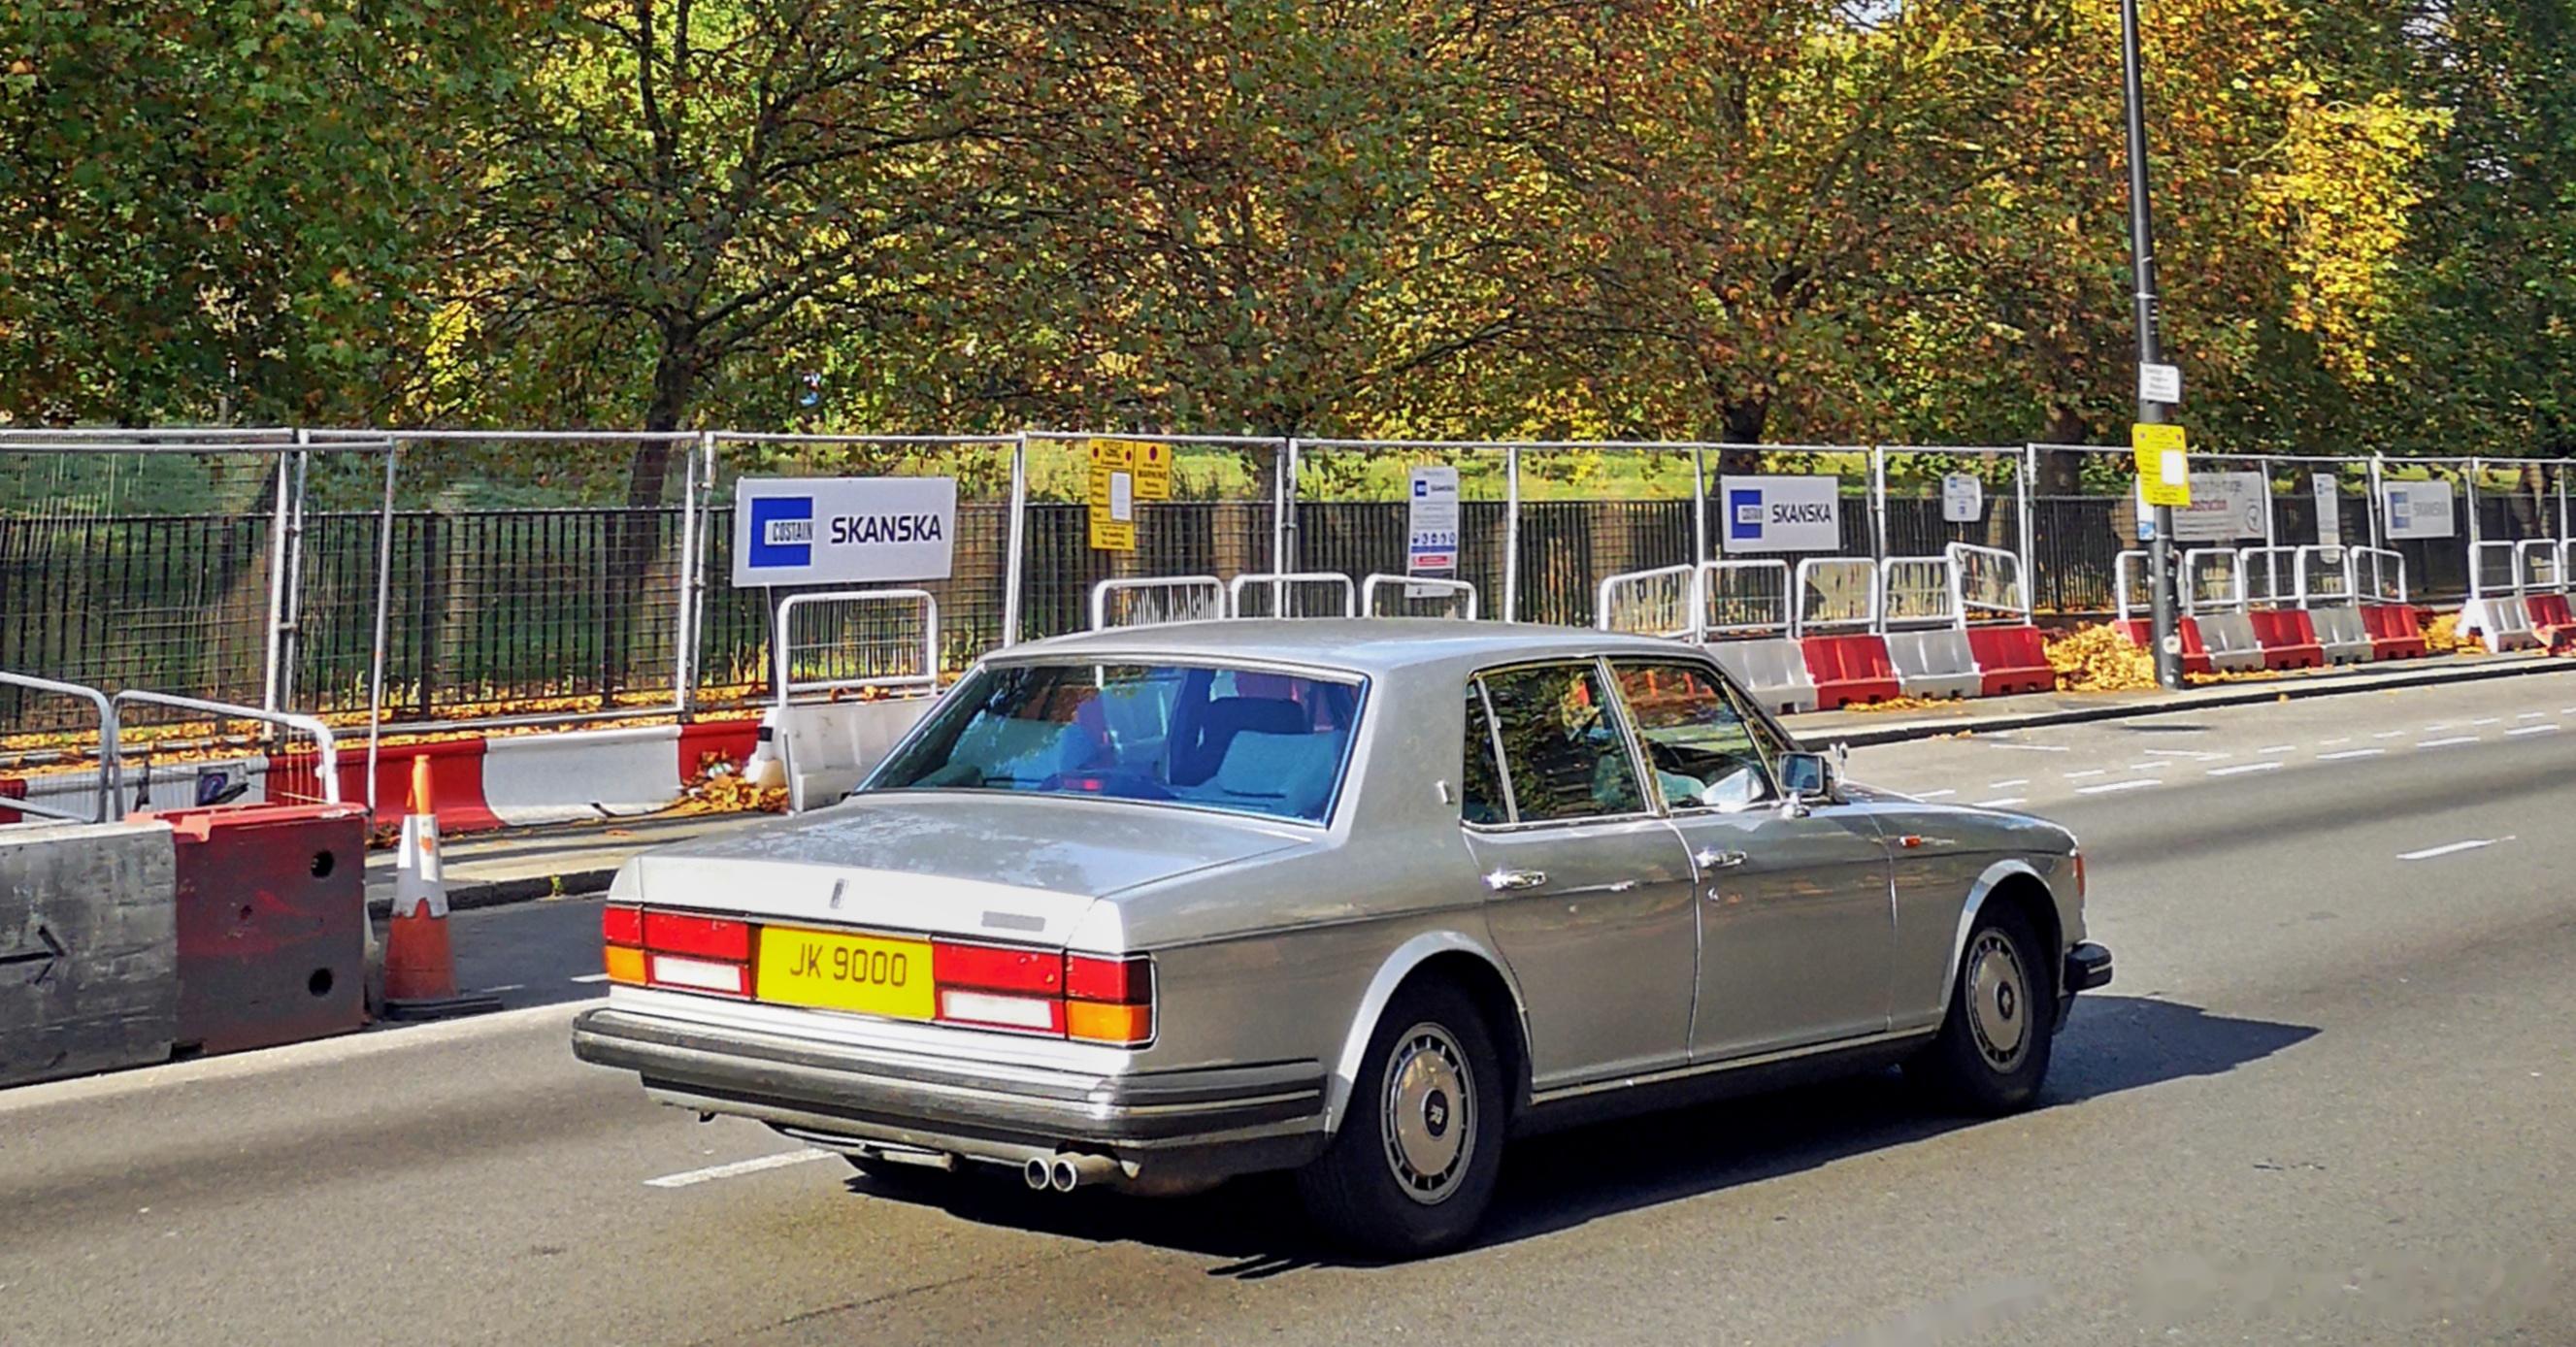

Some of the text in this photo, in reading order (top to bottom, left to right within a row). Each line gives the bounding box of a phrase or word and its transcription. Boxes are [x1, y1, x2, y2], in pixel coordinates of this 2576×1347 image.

[1771, 504, 1832, 523] SKANSKA
[772, 514, 942, 543] COSTAIN SKANSKA
[789, 942, 908, 987] JK 9000
